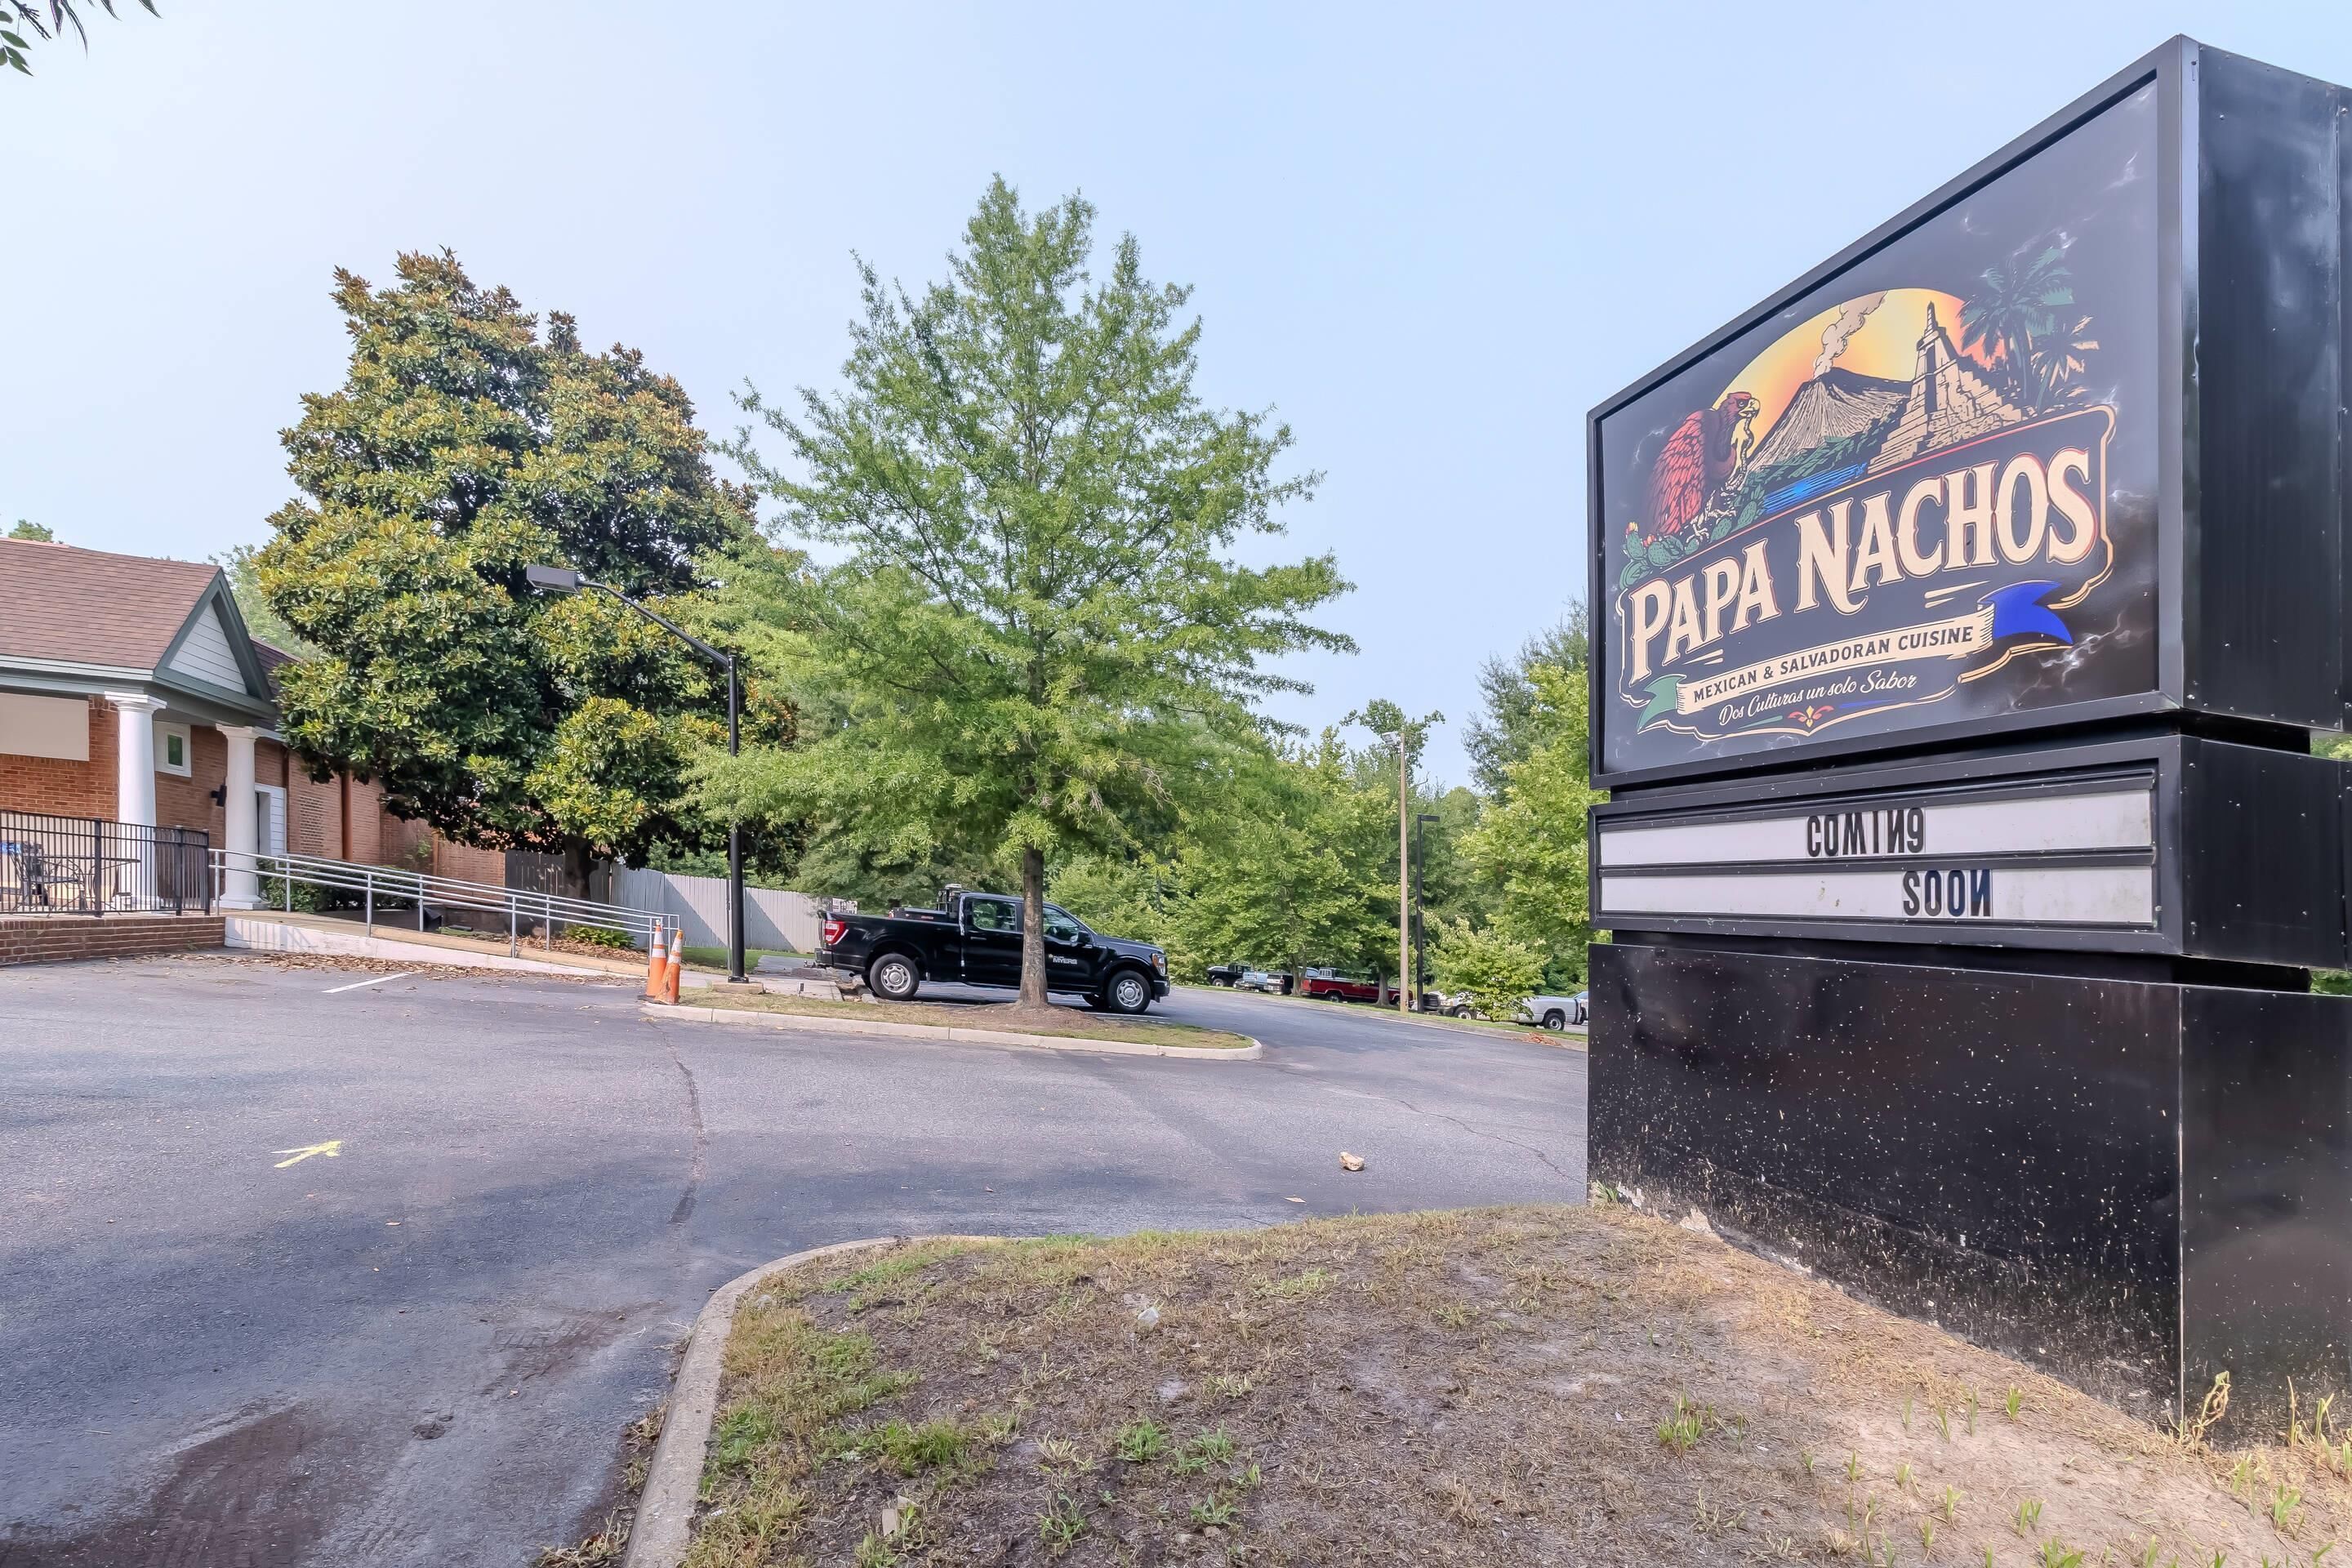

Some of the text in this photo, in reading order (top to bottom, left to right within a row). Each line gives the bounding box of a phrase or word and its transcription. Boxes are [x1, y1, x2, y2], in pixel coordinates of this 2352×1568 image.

[1629, 447, 2098, 687] PAPA NACHOS
[1694, 626, 1973, 702] MEXICAN & SALVADORAN CUISINE
[1719, 670, 1918, 725] Dos Culturas un solo Sabor
[1903, 869, 1991, 917] SOON
